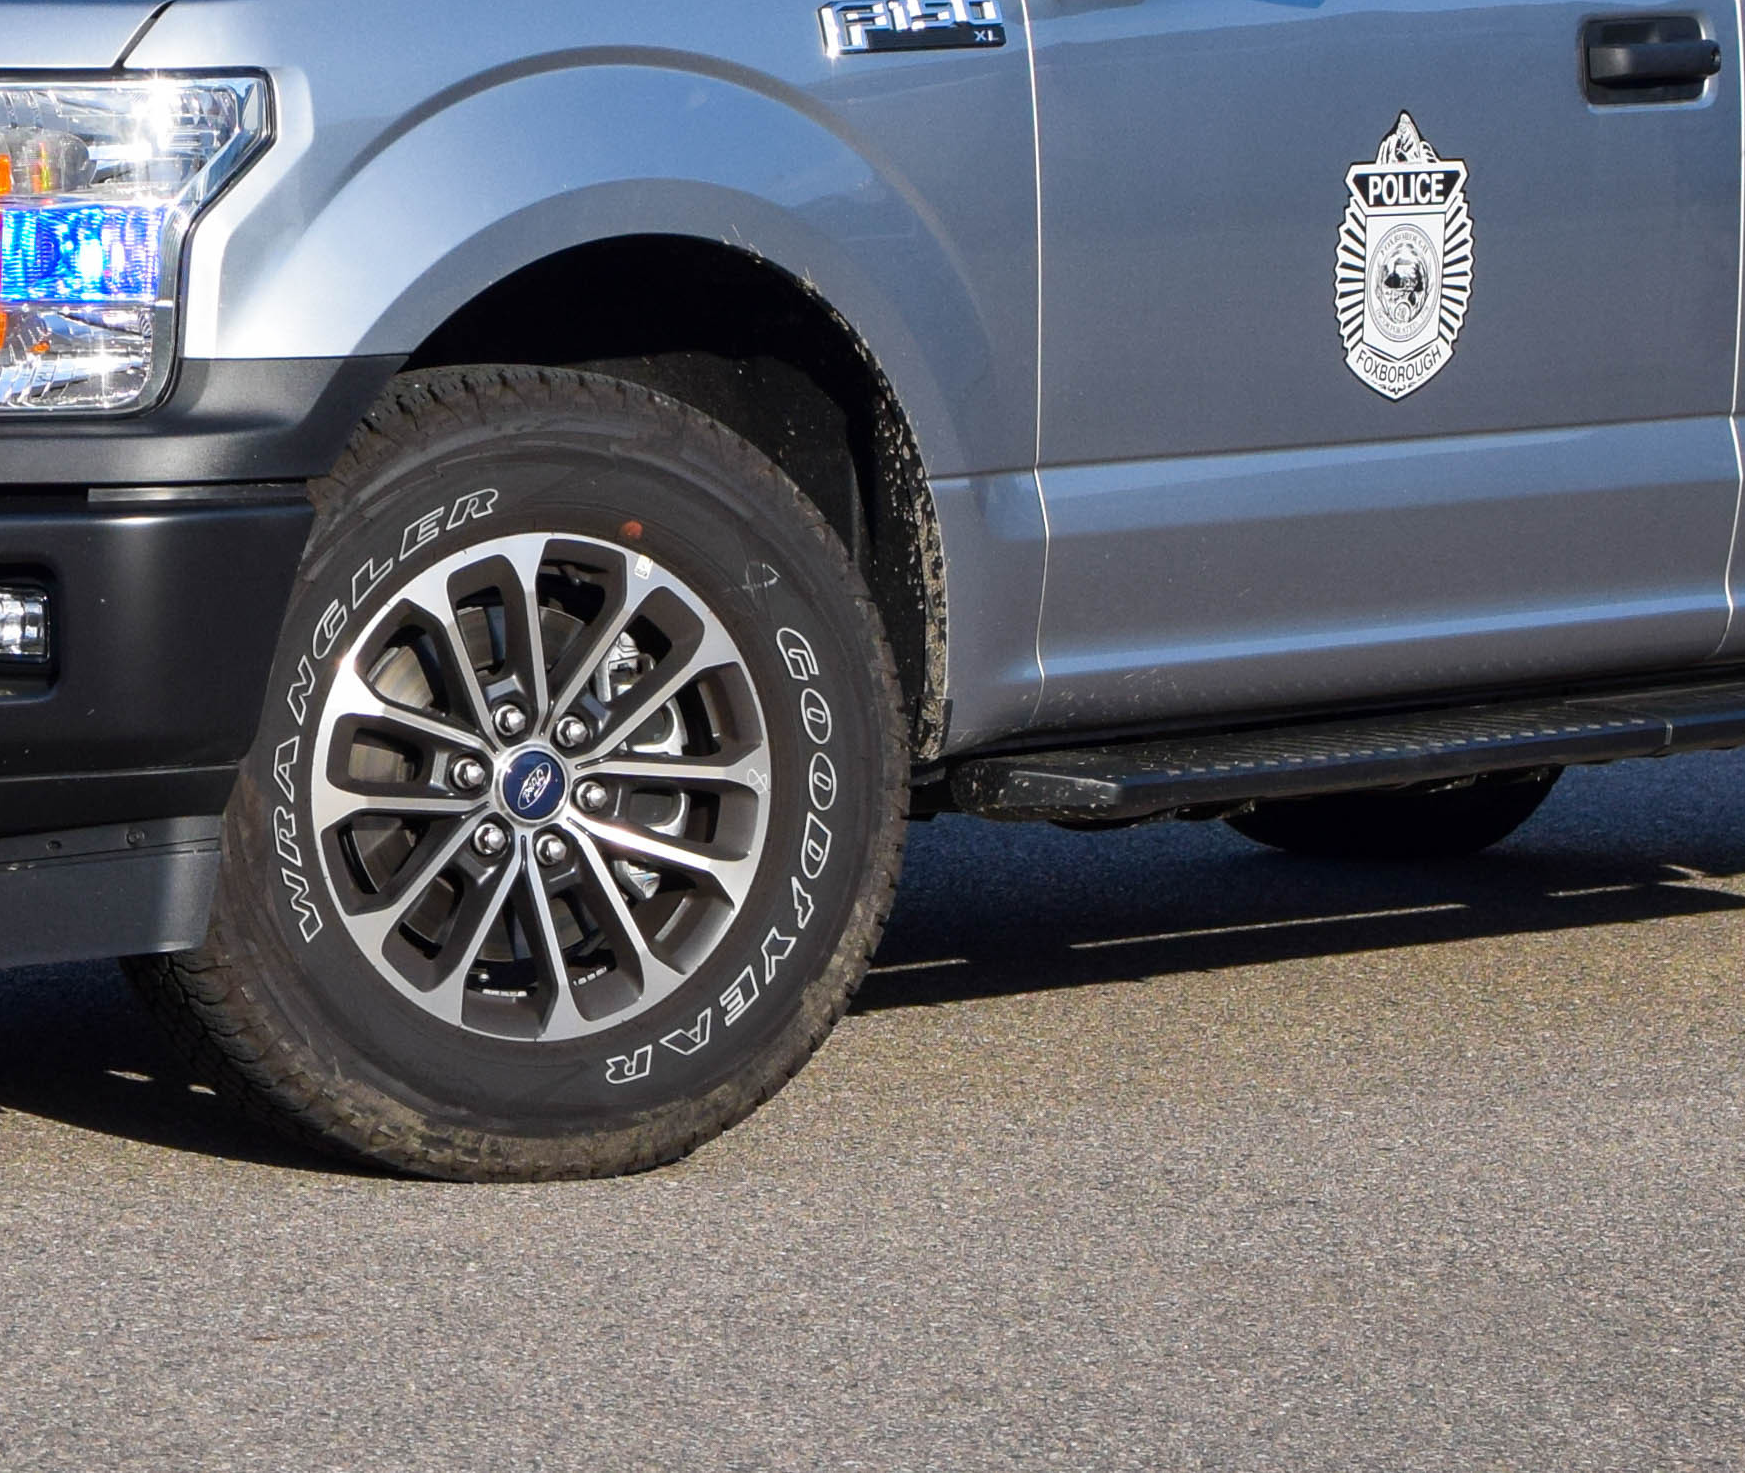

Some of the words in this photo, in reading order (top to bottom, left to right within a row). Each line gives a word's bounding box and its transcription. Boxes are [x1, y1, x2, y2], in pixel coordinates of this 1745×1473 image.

[973, 30, 1000, 41] XL
[1368, 172, 1444, 206] POLICE
[1355, 343, 1443, 384] FOXBOROUGH
[270, 487, 500, 944] WRANGLER
[522, 768, 547, 804] Ford
[604, 627, 838, 1085] GOODYEAR
